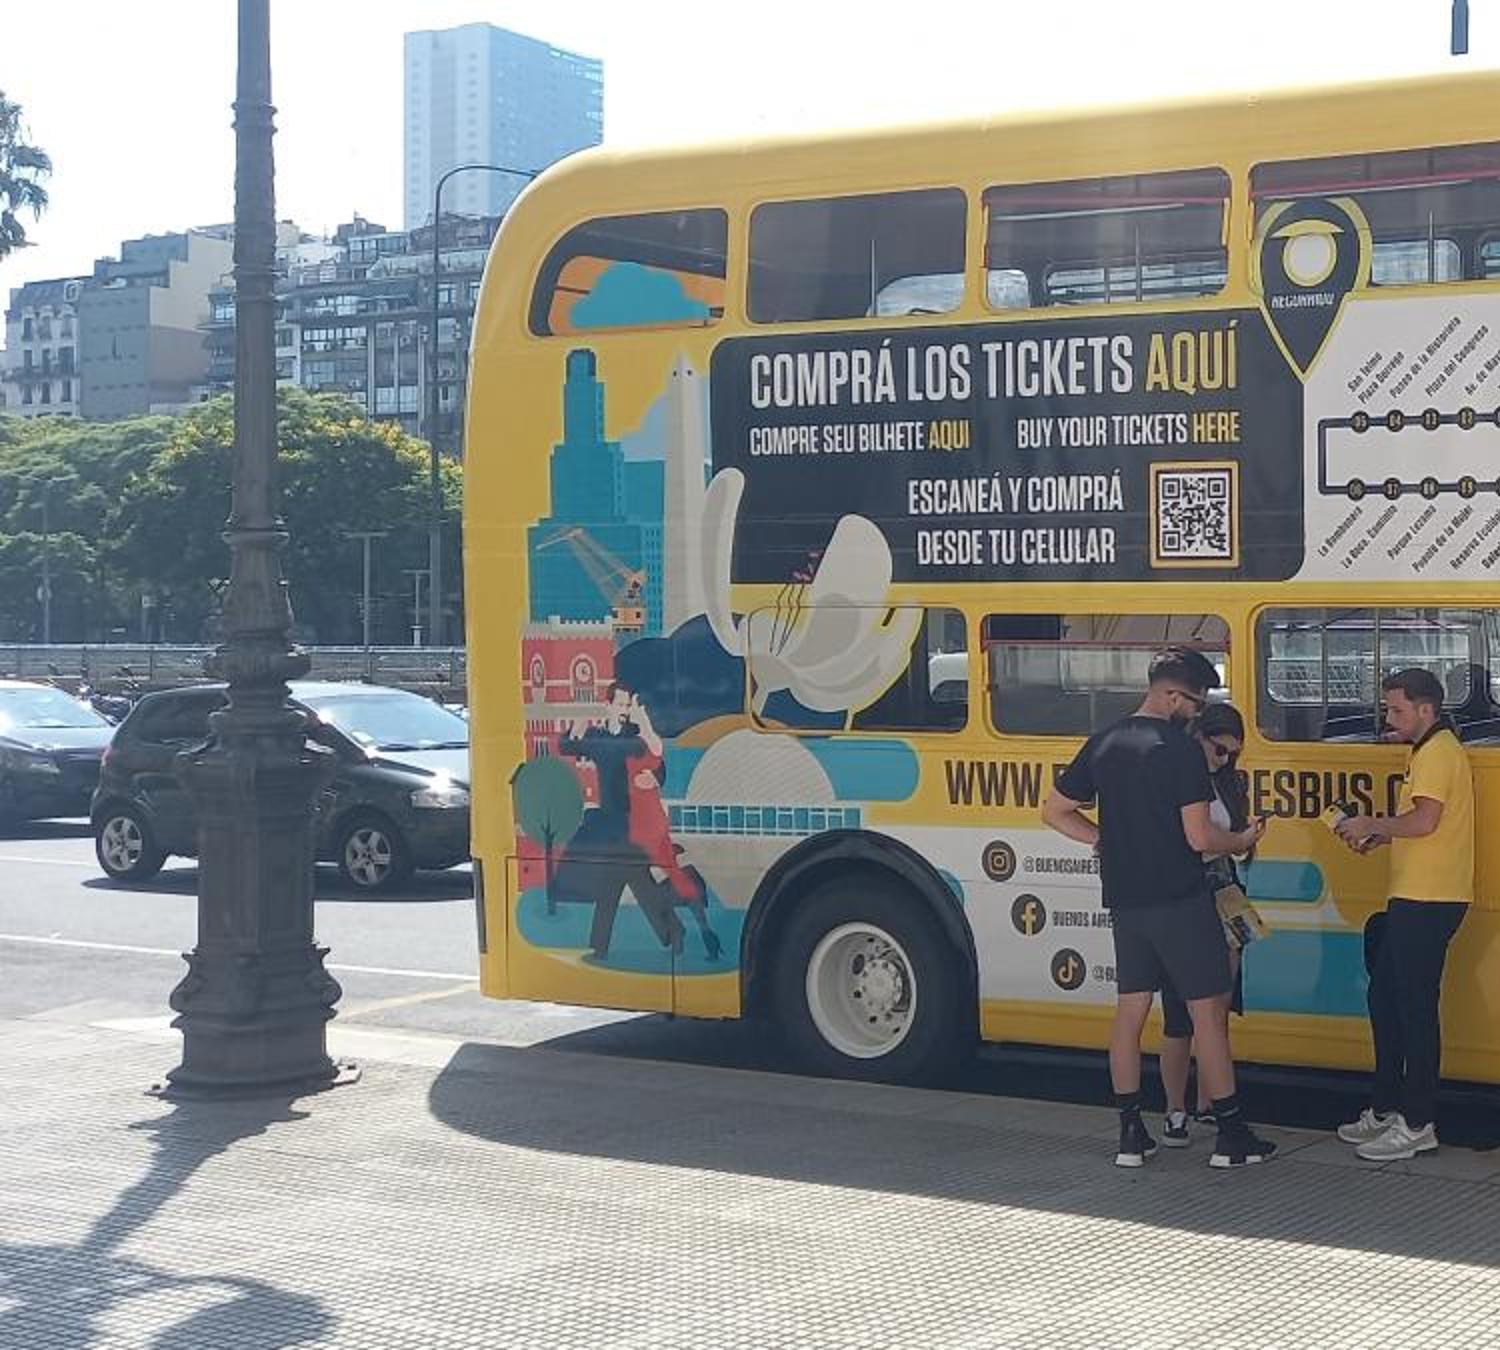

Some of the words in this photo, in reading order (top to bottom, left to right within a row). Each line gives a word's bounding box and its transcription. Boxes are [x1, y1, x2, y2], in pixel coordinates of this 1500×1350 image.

[750, 339, 896, 408] COMPRÁ
[907, 344, 971, 402] LOS
[982, 335, 1133, 398] TICKETS
[1145, 320, 1237, 393] AQUÍ
[1425, 373, 1447, 397] Plaza
[1444, 360, 1457, 377] del
[1453, 325, 1489, 364] Congreso
[1348, 375, 1364, 392] San
[1358, 381, 1378, 404] Plaza
[750, 423, 819, 455] COMPRE
[823, 422, 855, 453] SEU
[859, 420, 924, 451] BILHETE
[928, 419, 970, 450] AQUI
[1017, 417, 1054, 448] BUY
[1056, 416, 1108, 447] YOUR
[1111, 413, 1188, 445] TICKETS
[1194, 412, 1240, 443] HERE
[908, 471, 1002, 515] ESCANEÁ
[1007, 478, 1021, 512] Y
[1027, 467, 1123, 513] COMPRÁ
[918, 531, 984, 567] DESDE
[988, 530, 1016, 565] TU
[1021, 528, 1115, 565] CELULAR
[1450, 538, 1480, 570] Reserva
[1052, 911, 1089, 927] BUENOS
